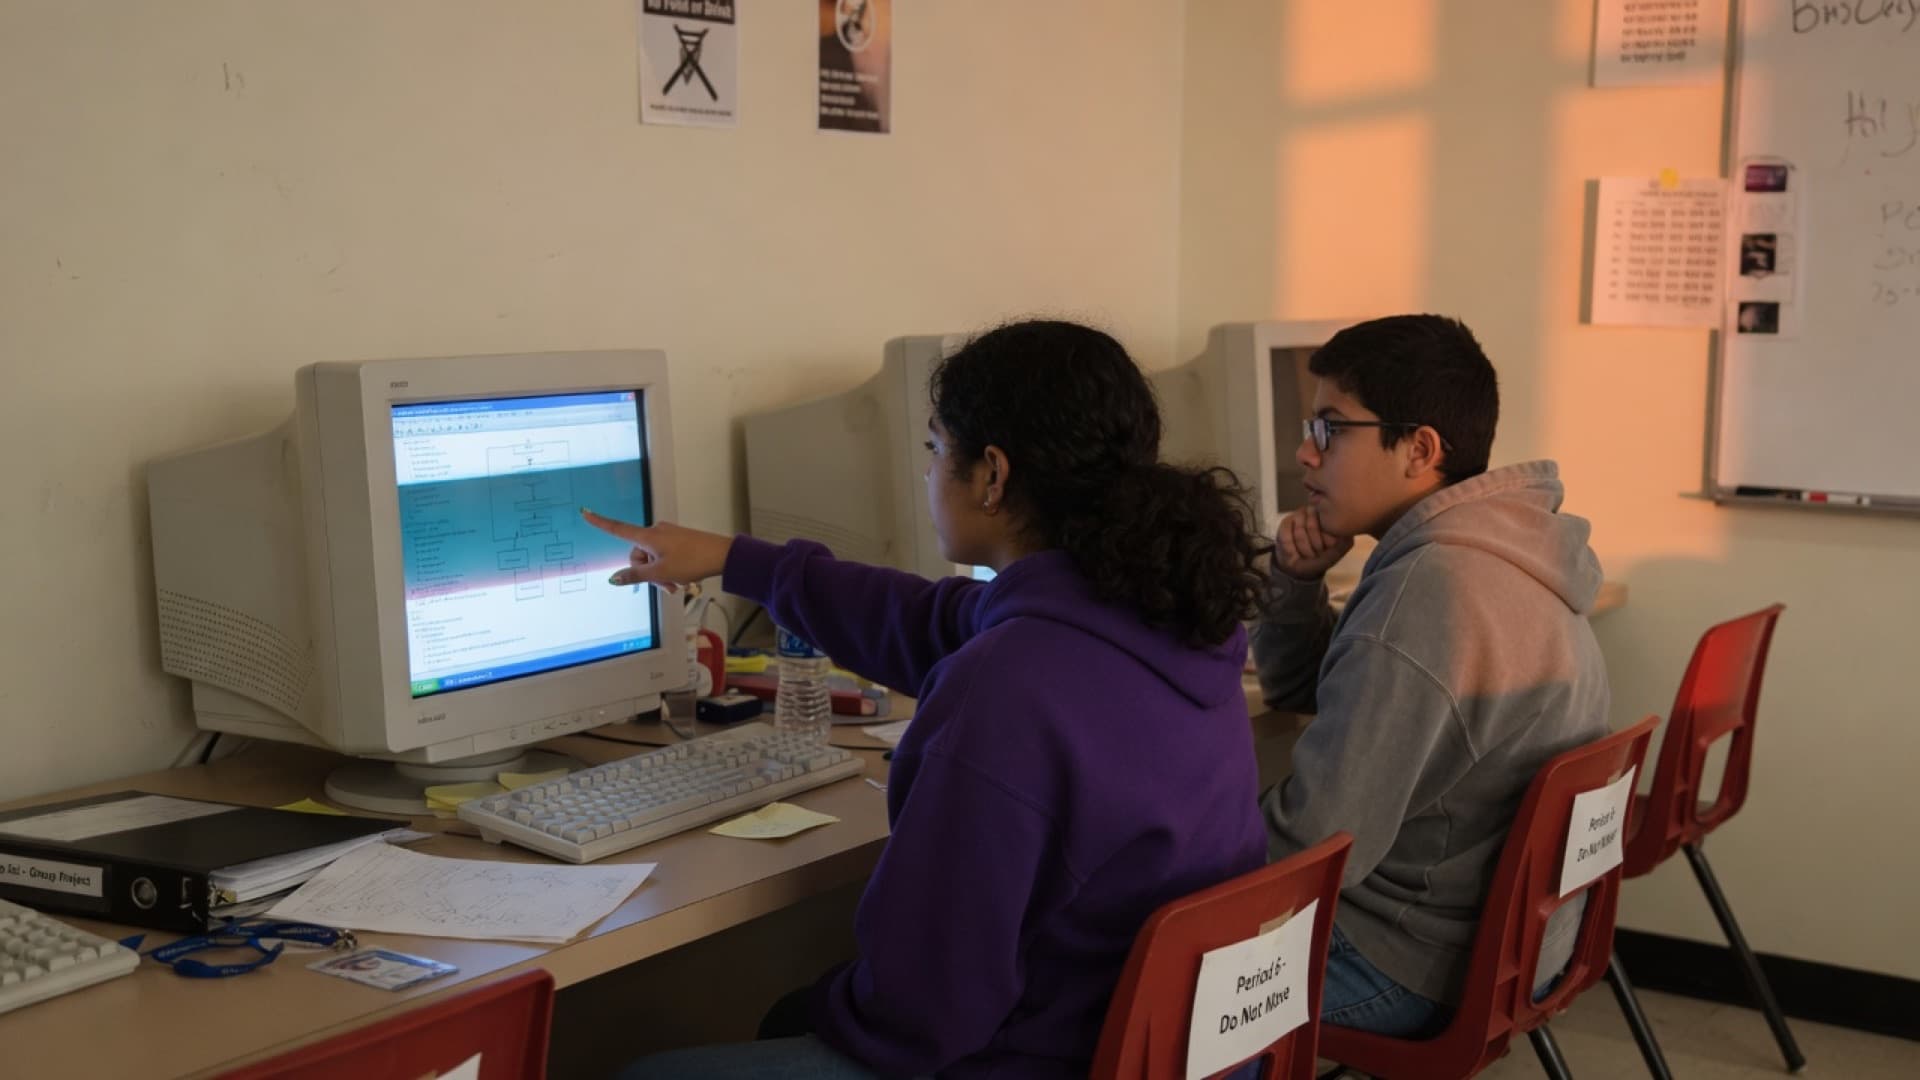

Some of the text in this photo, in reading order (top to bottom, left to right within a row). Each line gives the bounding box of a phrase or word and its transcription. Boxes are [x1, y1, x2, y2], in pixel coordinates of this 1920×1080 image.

[1236, 961, 1274, 994] Period
[1219, 1014, 1238, 1034] Do
[1241, 1002, 1262, 1026] Not
